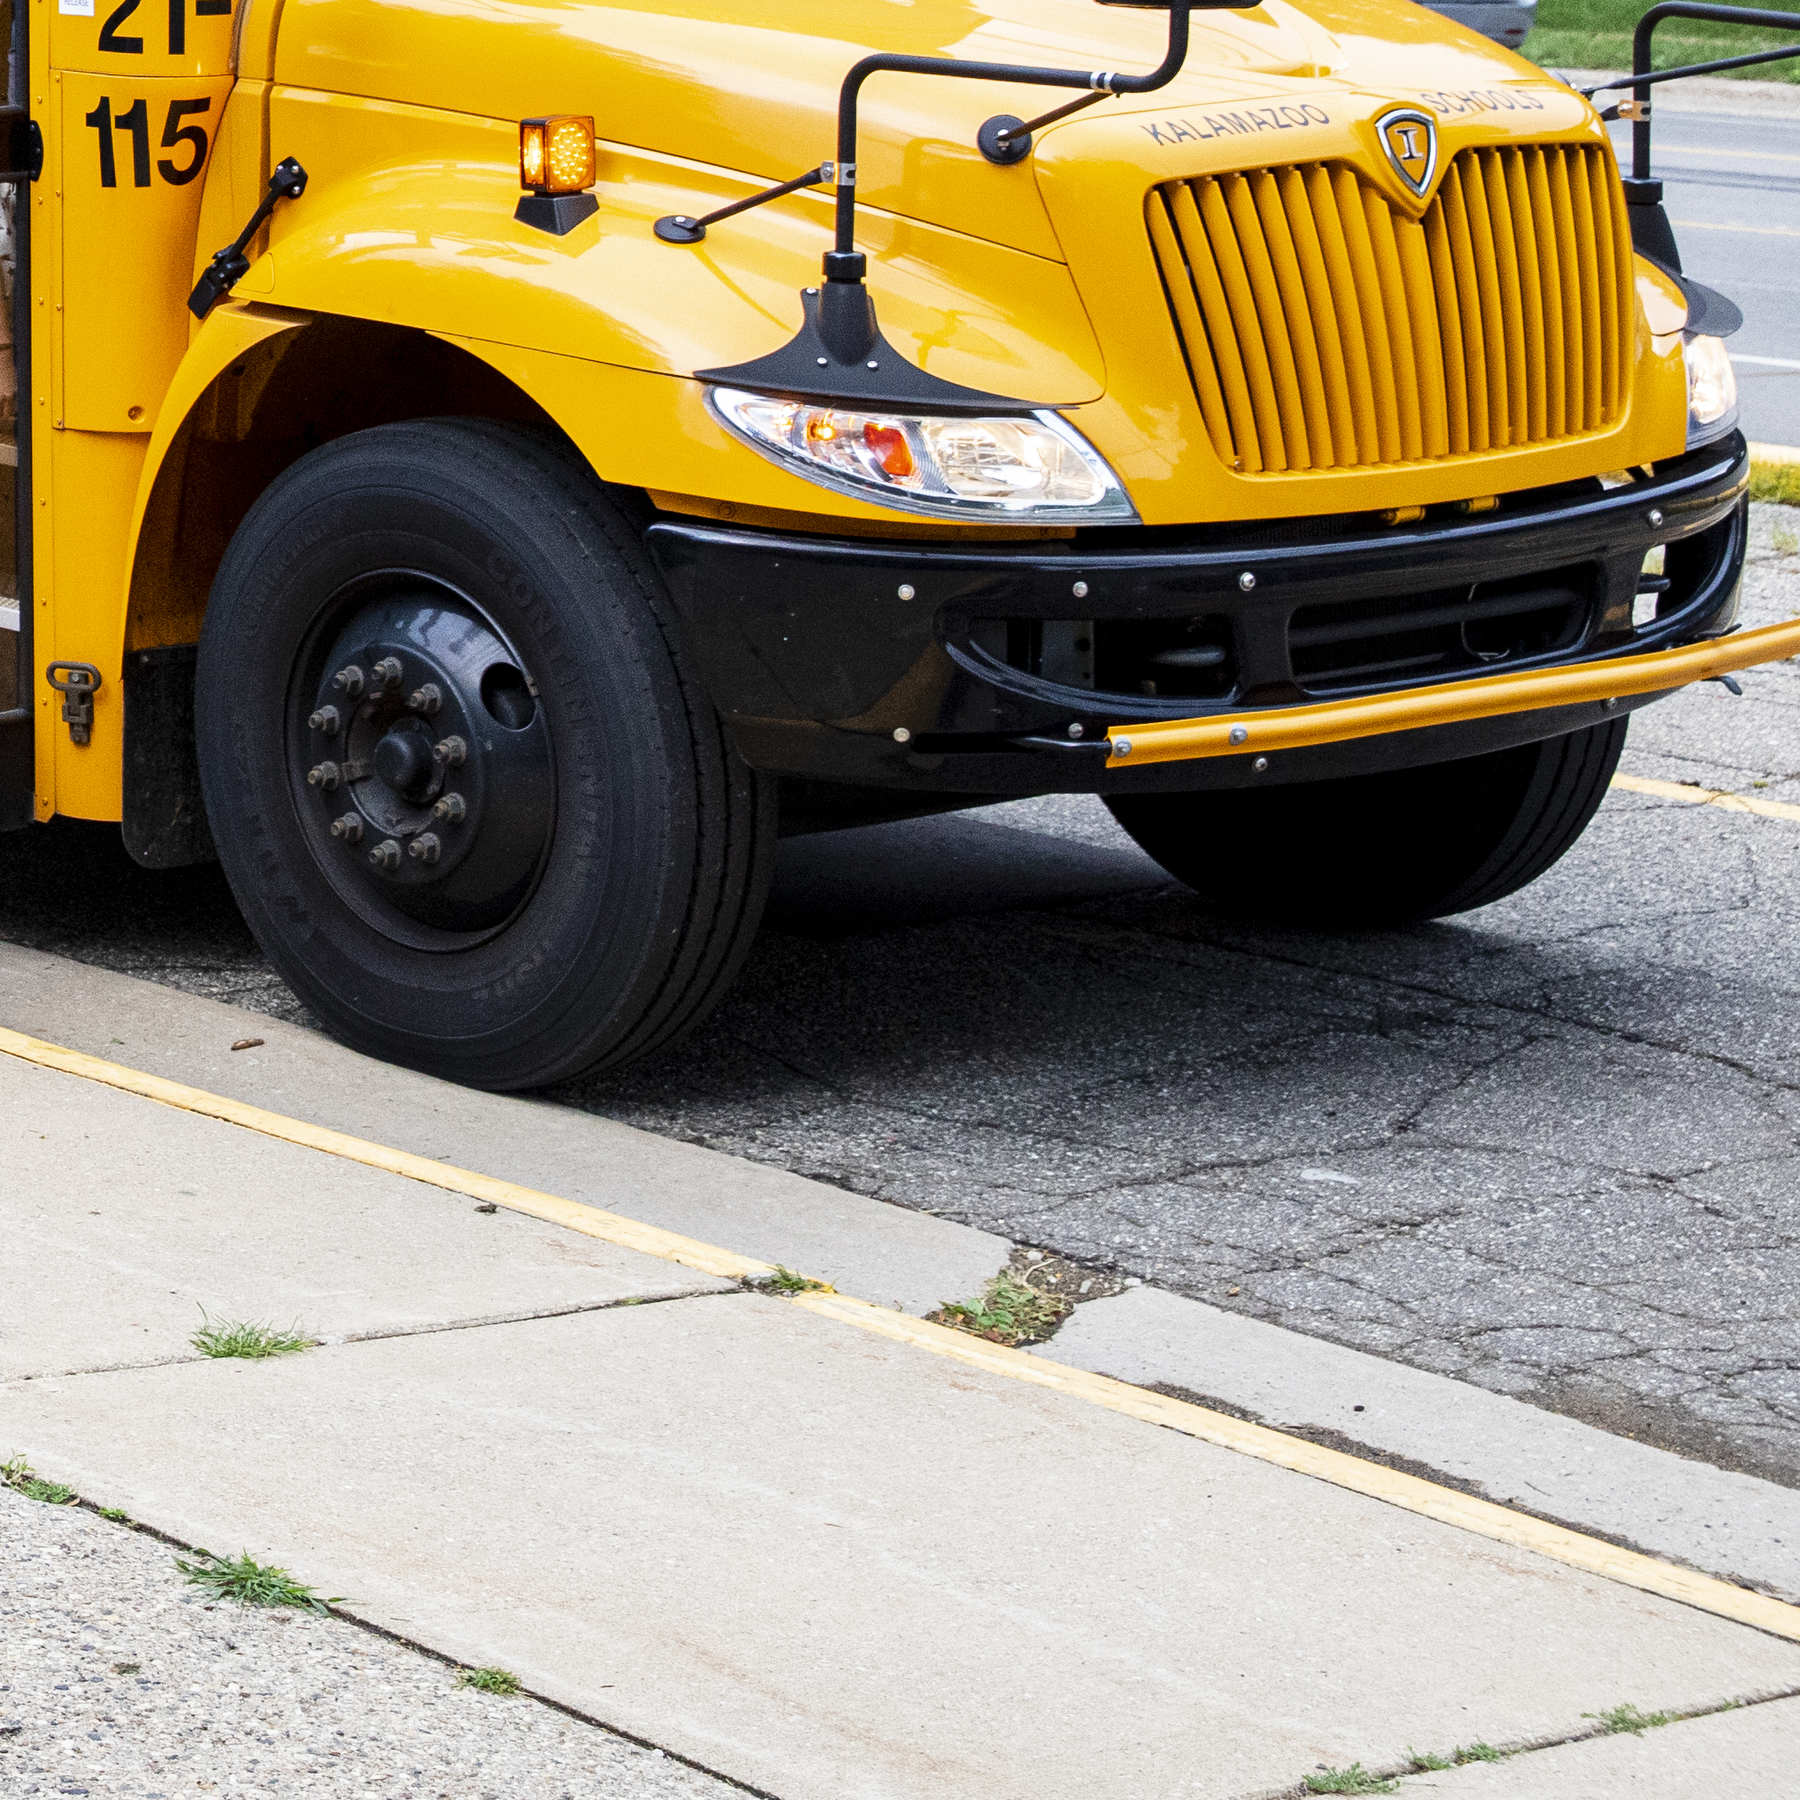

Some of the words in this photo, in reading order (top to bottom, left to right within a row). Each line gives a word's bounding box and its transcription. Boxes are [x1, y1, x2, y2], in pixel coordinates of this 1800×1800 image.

[85, 96, 211, 188] 115
[1138, 103, 1330, 146] KALAMAZOO
[1420, 89, 1545, 114] SCHOOLS
